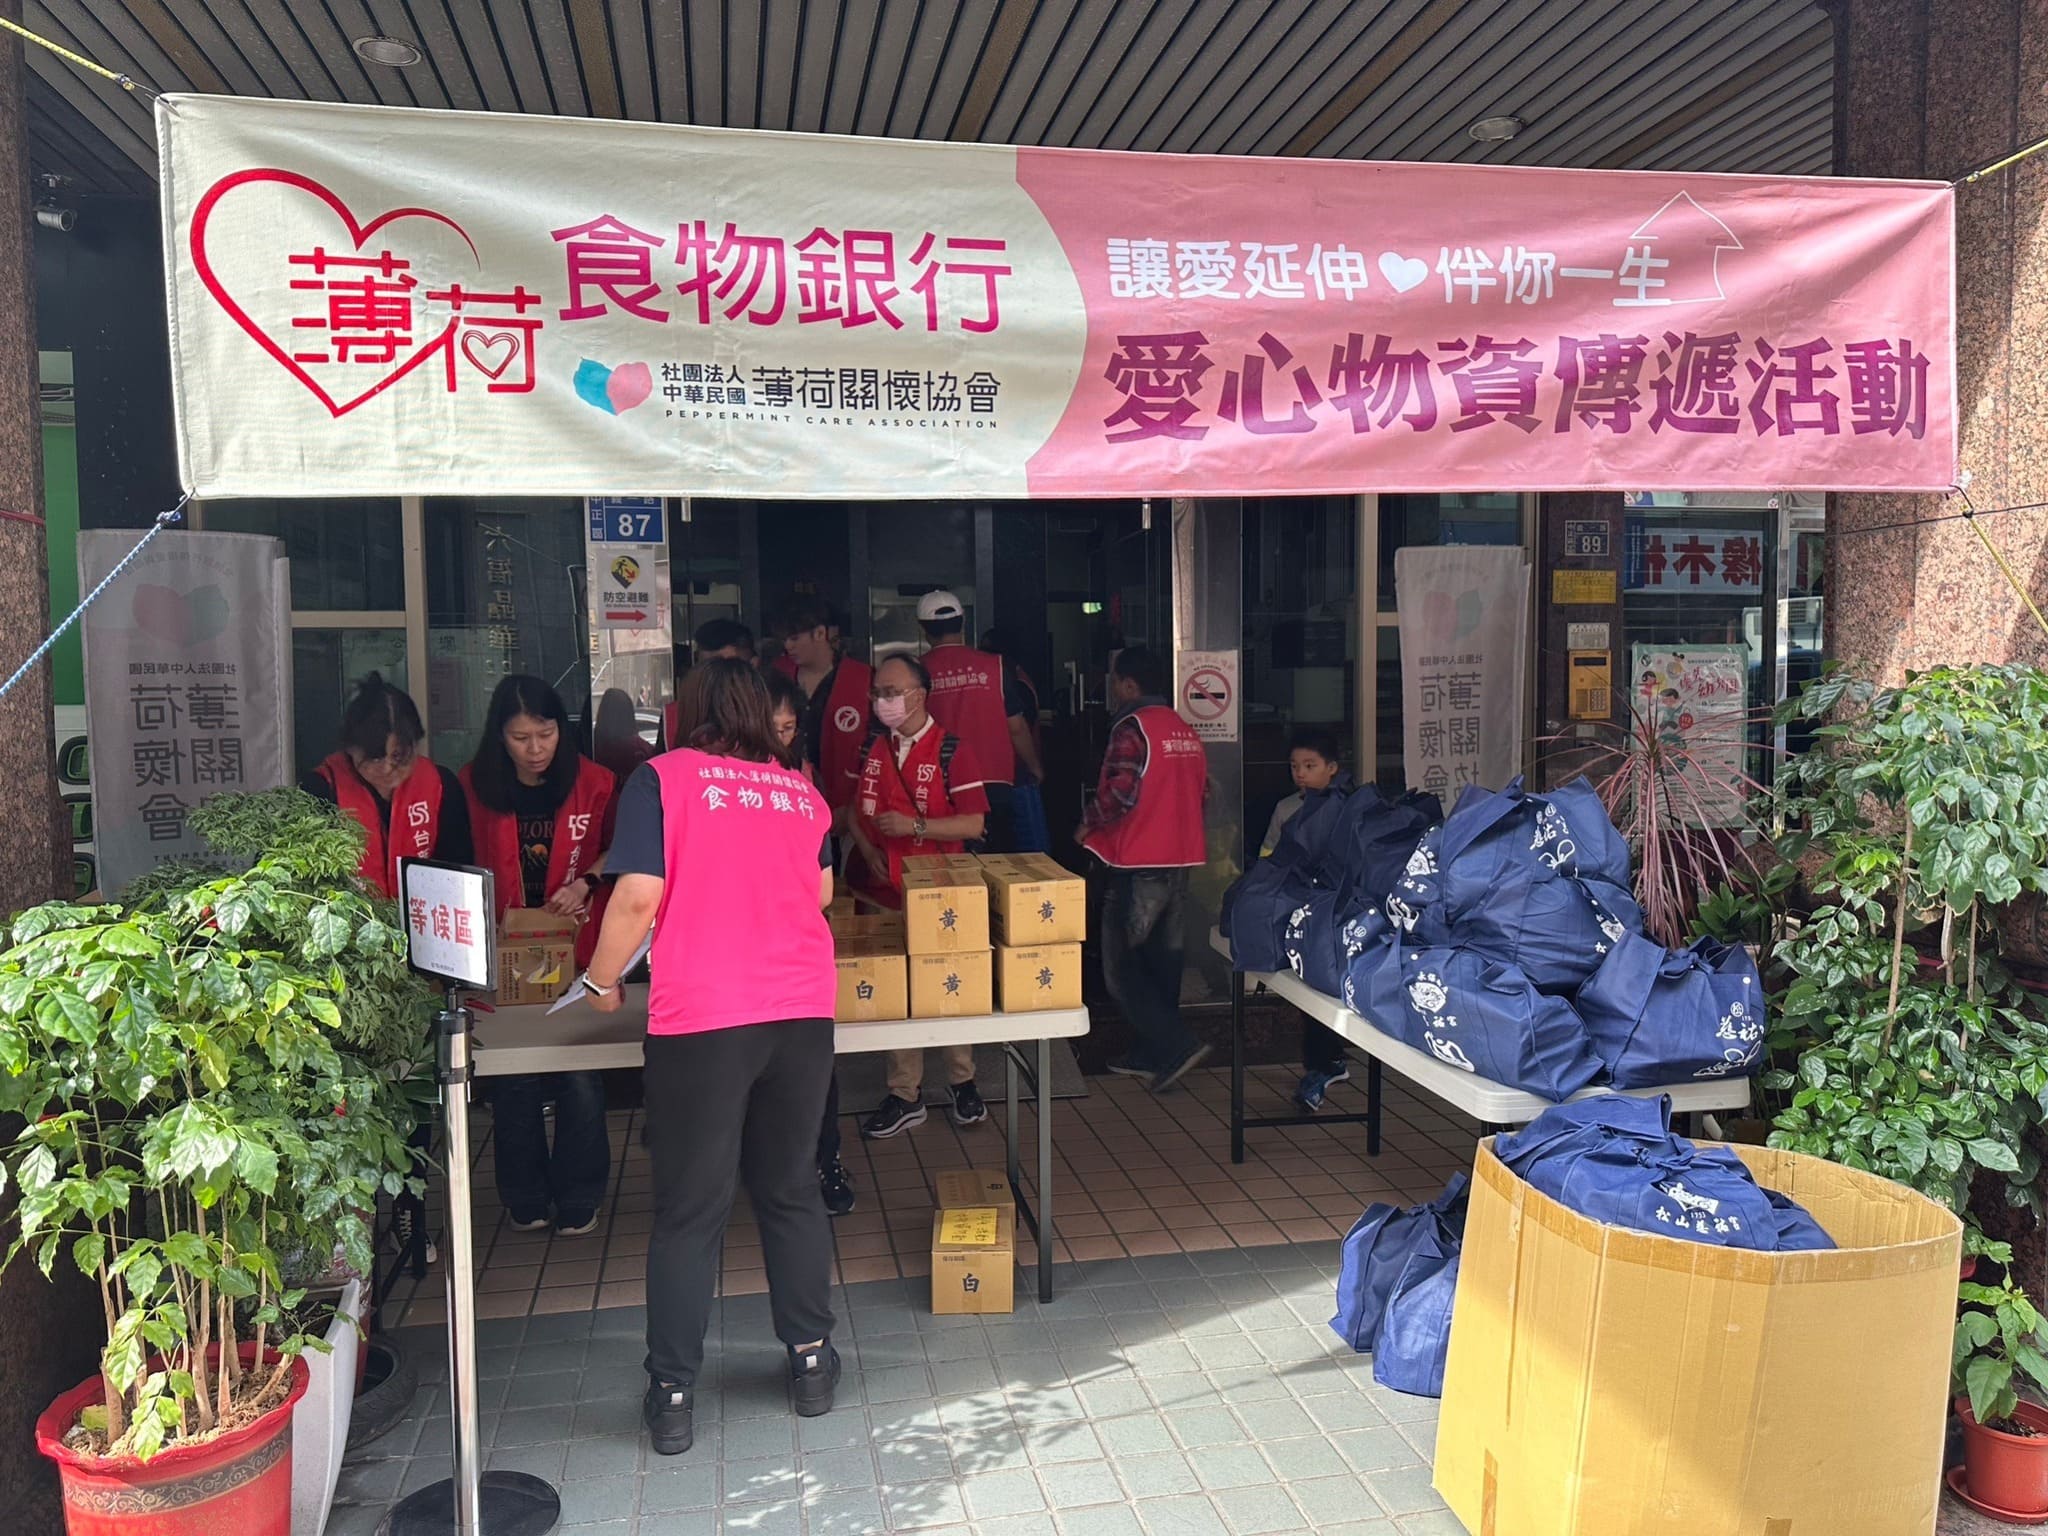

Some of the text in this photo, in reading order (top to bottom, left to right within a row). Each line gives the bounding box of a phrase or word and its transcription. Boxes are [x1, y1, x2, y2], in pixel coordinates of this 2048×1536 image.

[550, 213, 1012, 334] 食物銀行
[1107, 234, 1671, 308] 讓愛延伸 伴你一生
[288, 247, 542, 393] 薄荷
[661, 362, 745, 384] 社團法人
[663, 383, 747, 405] 中華民國
[751, 366, 1001, 413] 薄荷關懷協會
[1104, 329, 1930, 446] 愛心物資傳遞活動
[666, 409, 998, 429] PEPPERMINT CARE ASSOCIATION
[618, 513, 651, 536] 87
[1582, 535, 1601, 553] 89
[701, 783, 814, 820] 食物銀行
[409, 896, 475, 947] 等候區
[939, 907, 959, 932] 黃
[1037, 900, 1056, 924] 黃
[856, 980, 874, 1000] 白
[942, 973, 962, 997] 黃
[1035, 966, 1055, 990] 黃
[1715, 1014, 1765, 1042] 慈祐
[962, 1273, 980, 1293] 白
